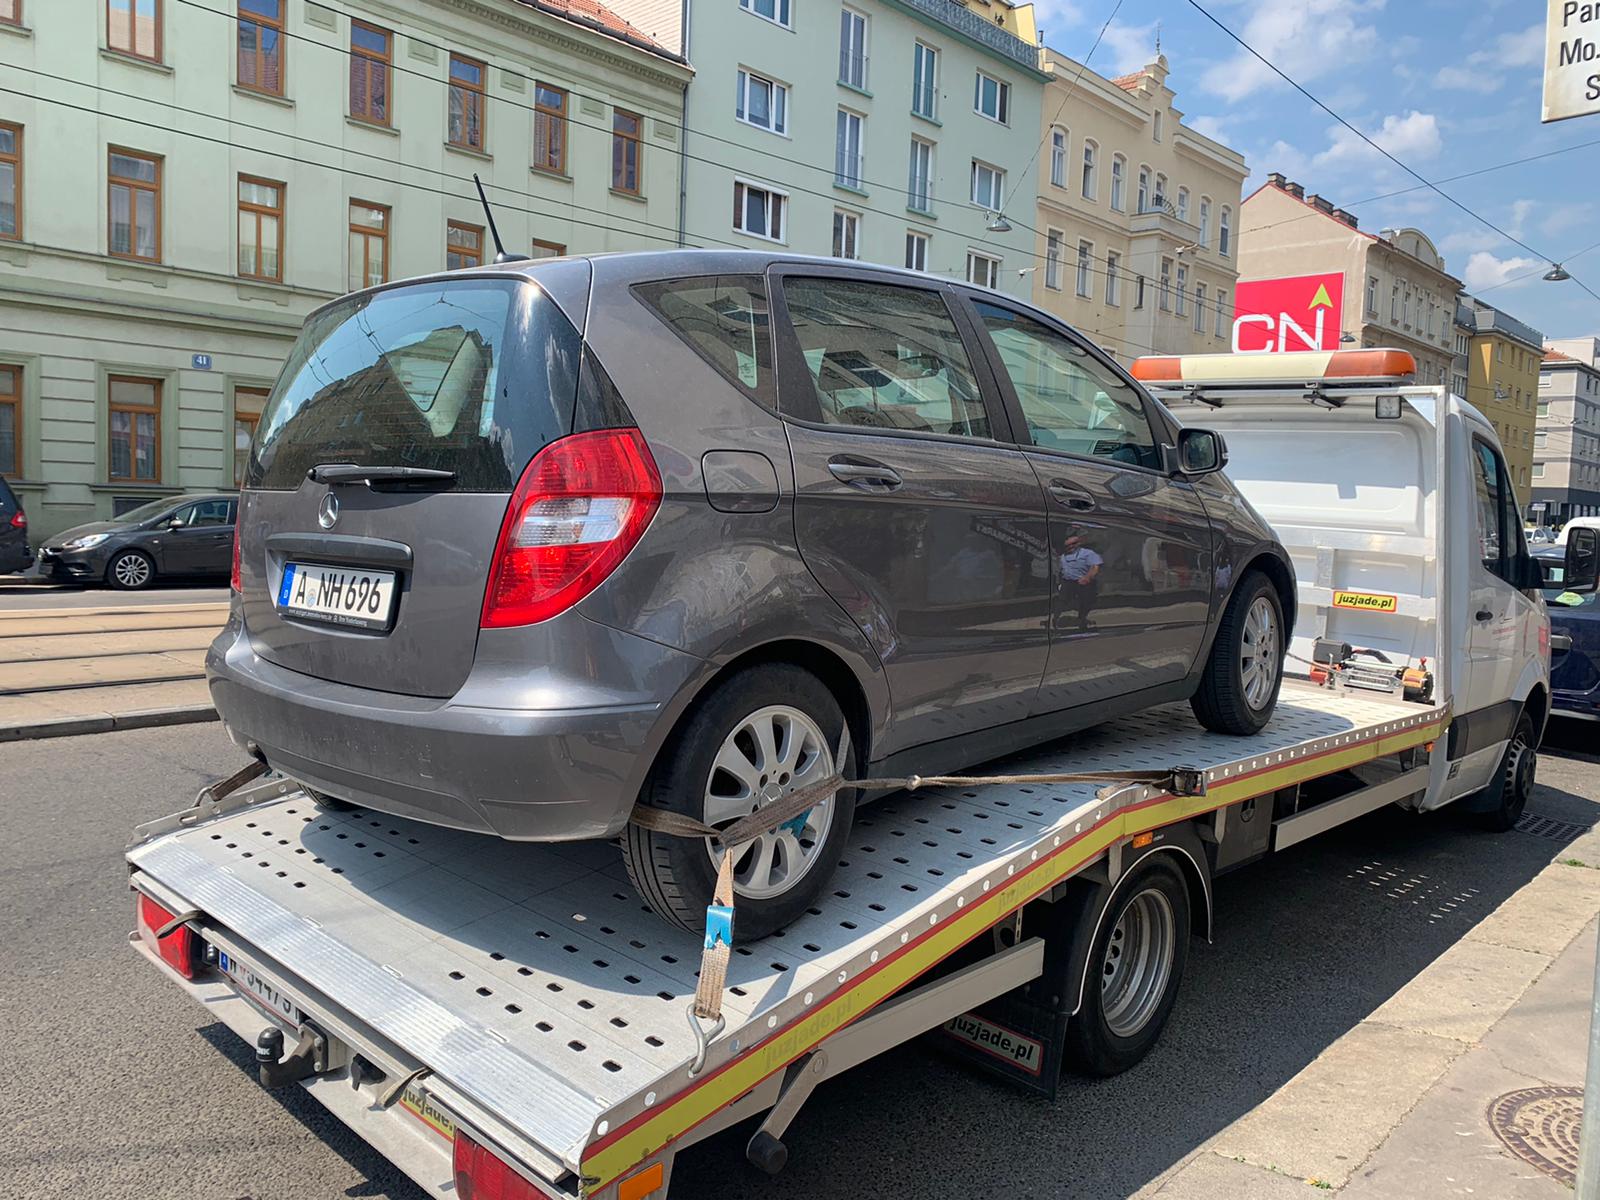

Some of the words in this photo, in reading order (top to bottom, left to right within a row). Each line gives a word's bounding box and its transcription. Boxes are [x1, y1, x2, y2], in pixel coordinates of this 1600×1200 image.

[196, 355, 206, 365] 41
[1337, 593, 1393, 608] juzjade.pl
[949, 1017, 1034, 1060] juzjade.pl
